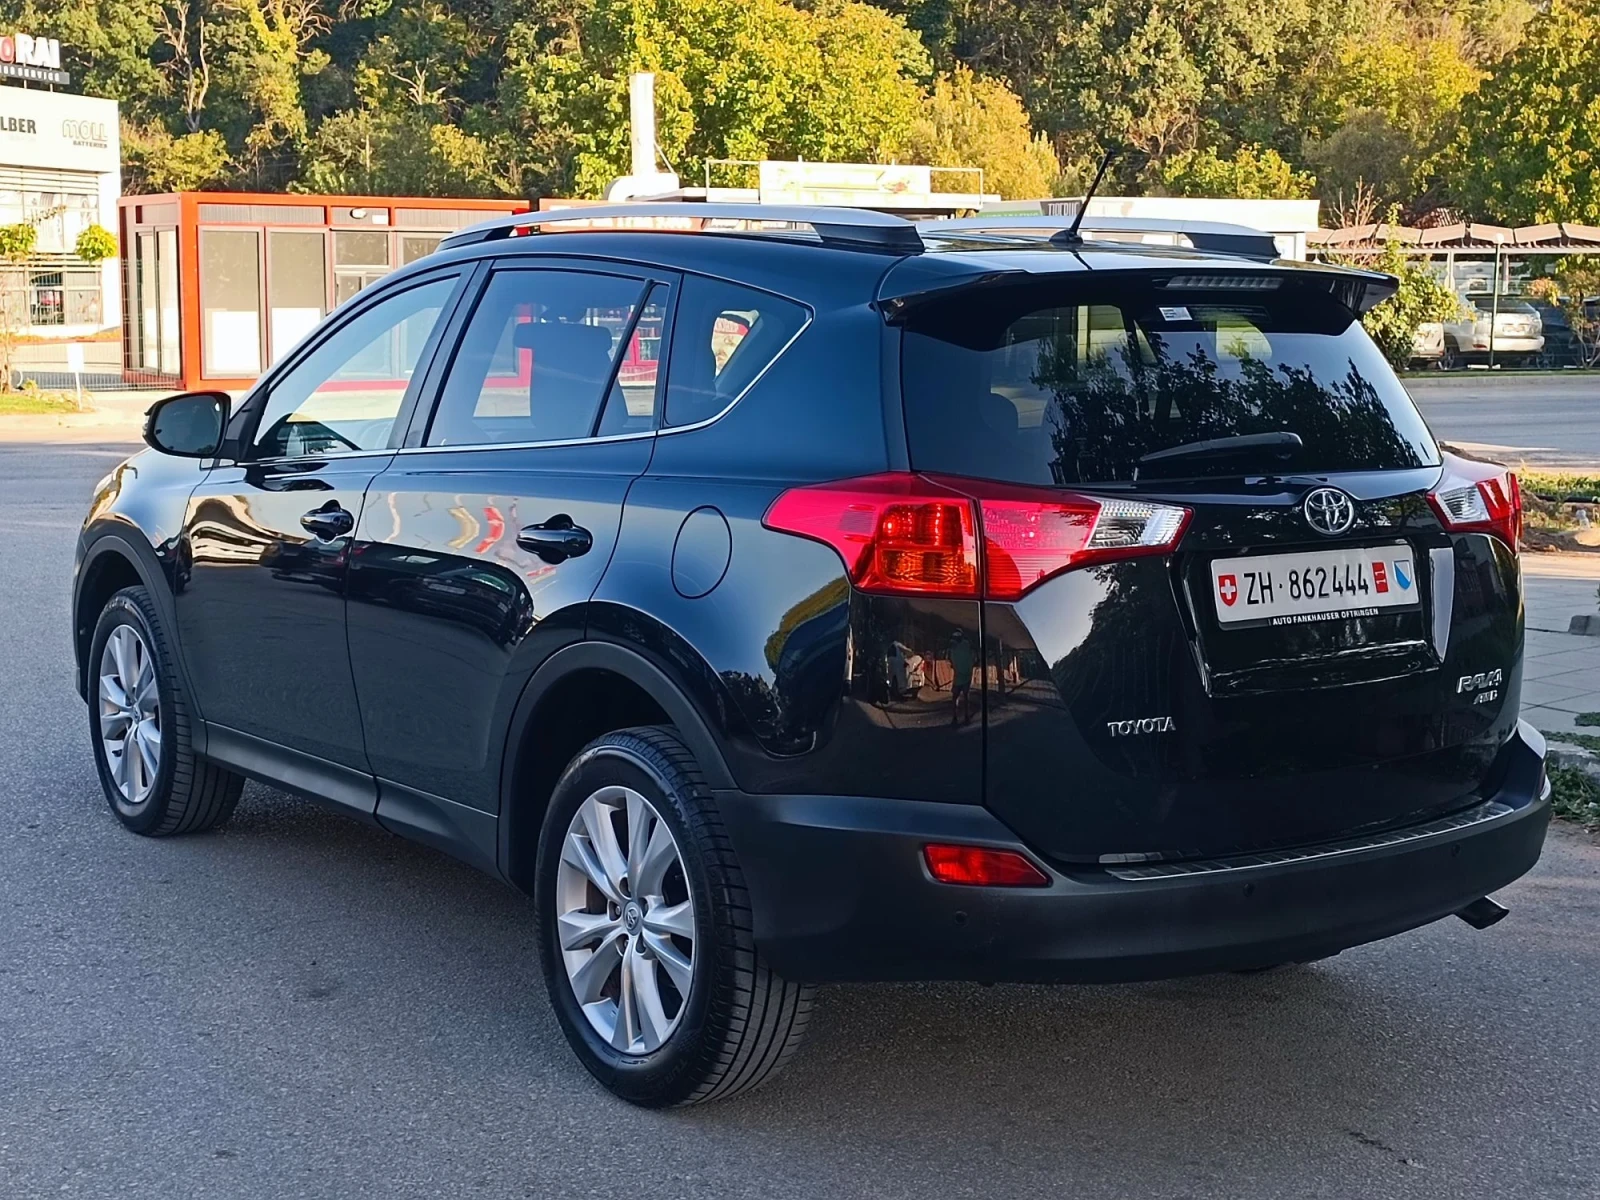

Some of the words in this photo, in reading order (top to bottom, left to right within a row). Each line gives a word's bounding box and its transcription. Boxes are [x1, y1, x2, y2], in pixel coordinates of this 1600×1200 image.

[1272, 617, 1292, 626] AUTO
[1293, 612, 1340, 623] FANKHAUSER
[1341, 608, 1379, 619] OFTRINGEN
[1456, 668, 1502, 693] RAV4
[1107, 716, 1176, 737] TOYOTA
